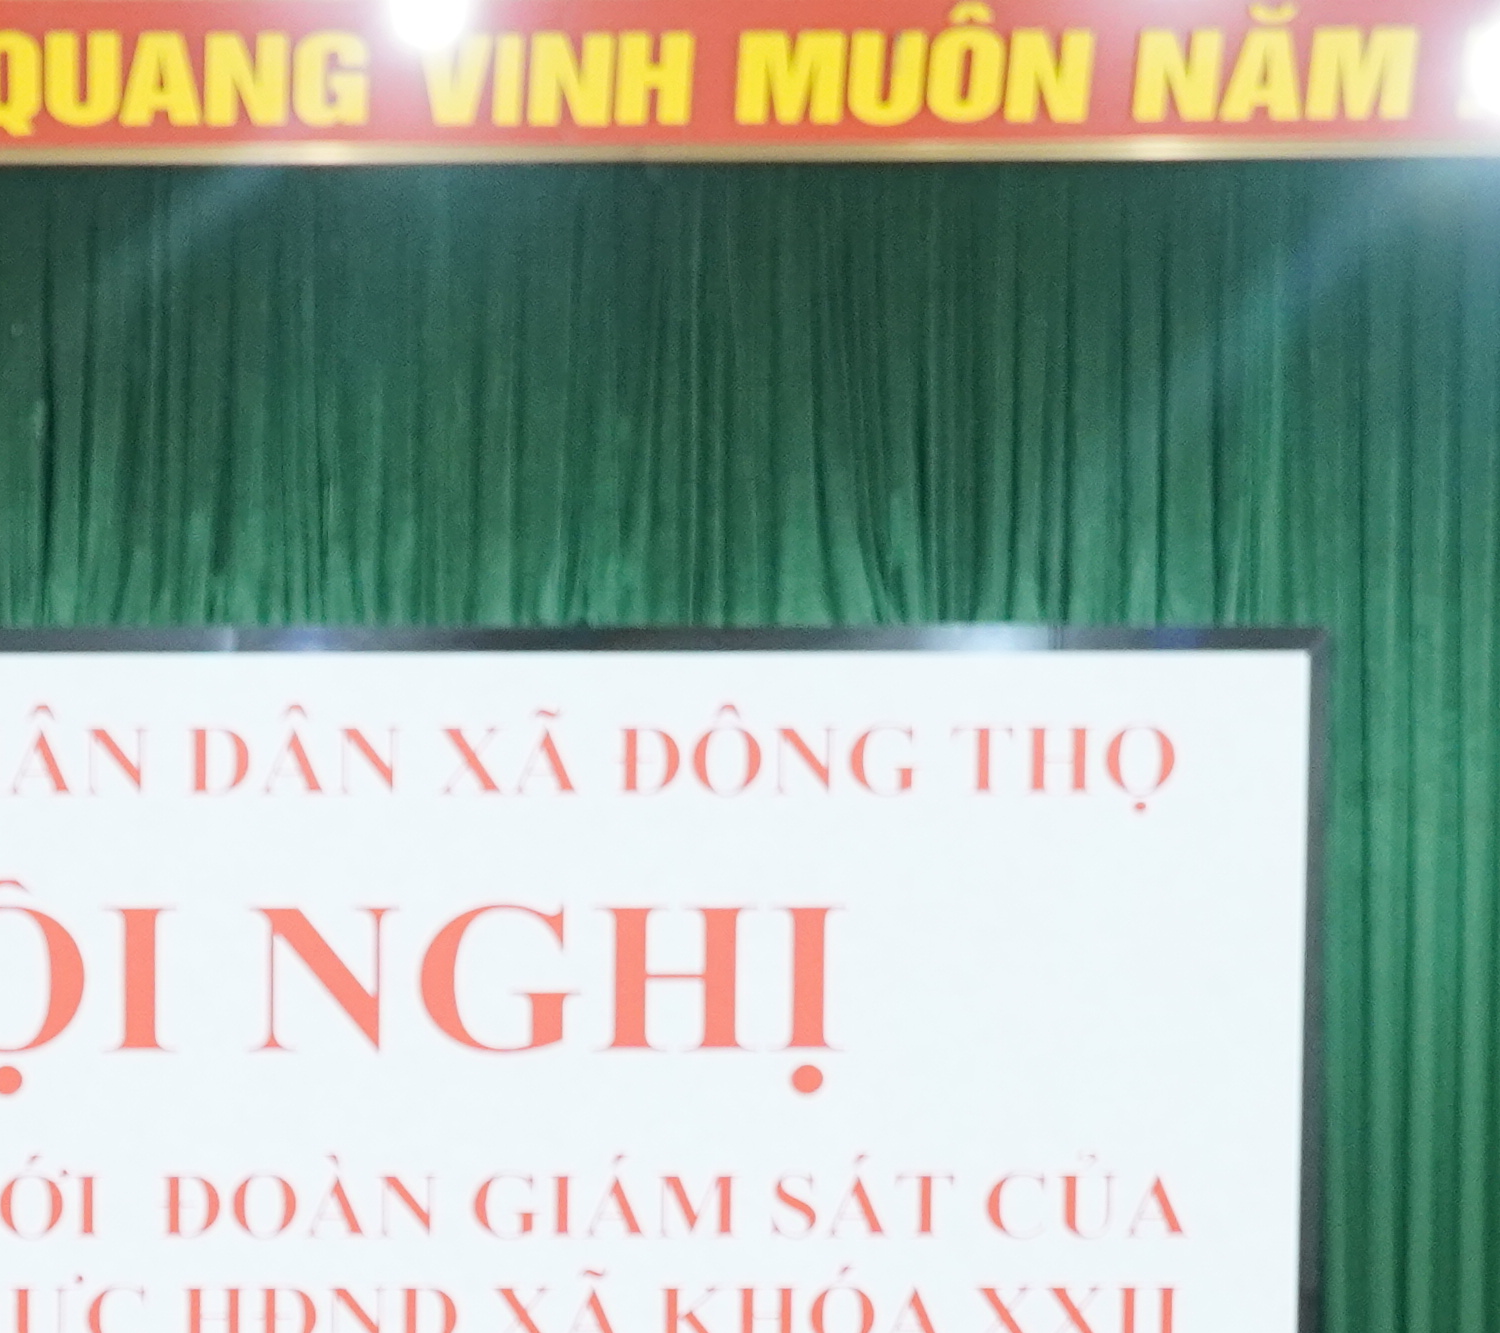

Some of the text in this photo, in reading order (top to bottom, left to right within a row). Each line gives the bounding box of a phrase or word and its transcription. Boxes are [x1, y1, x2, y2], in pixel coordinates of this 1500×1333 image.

[420, 30, 694, 128] VINH
[735, 8, 1093, 126] MUÔN
[1132, 0, 1420, 124] NĂM
[190, 703, 396, 796] DÂN
[440, 708, 580, 796] XÃ
[618, 703, 918, 796] ĐÔNG
[950, 724, 1178, 812] THỌ
[248, 904, 846, 1096] NGHỊ
[158, 1154, 436, 1238] ĐOÀN
[472, 1154, 736, 1238] GIÁM
[770, 1154, 956, 1238] SÁT
[984, 1152, 1186, 1238] CỦA
